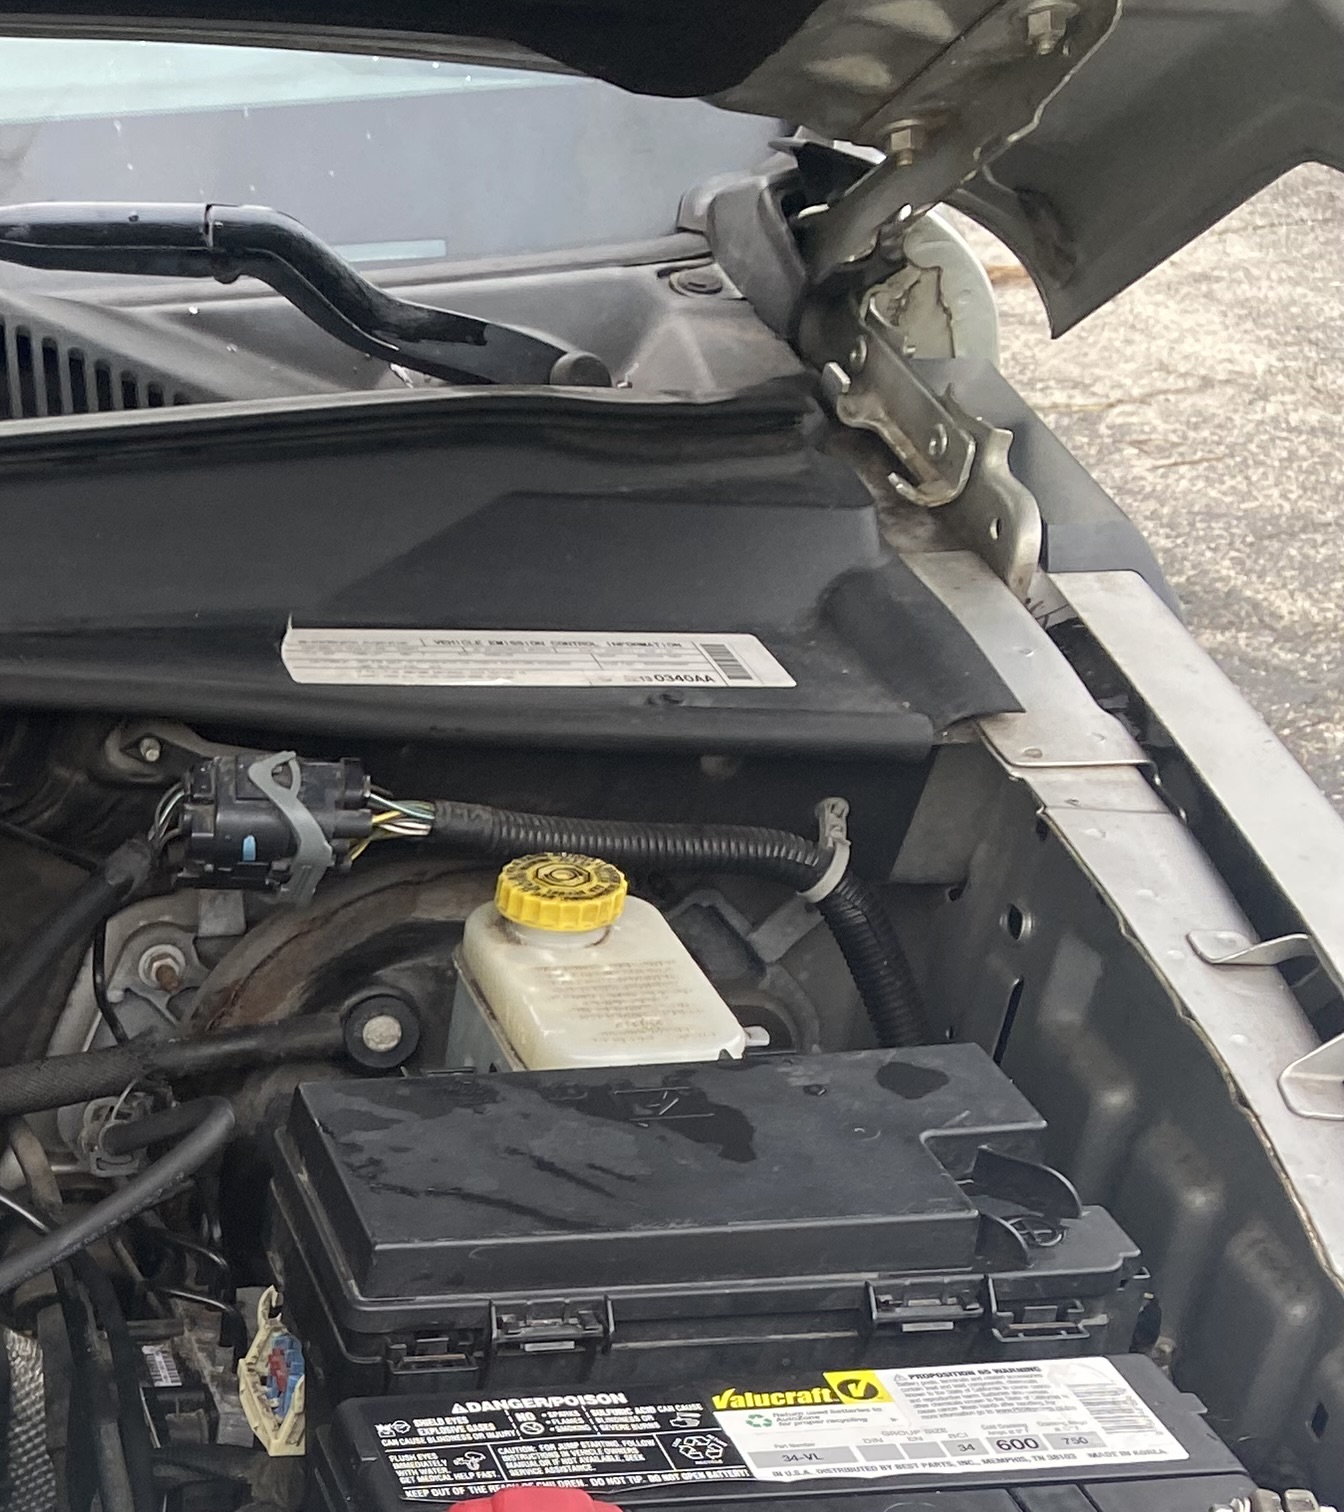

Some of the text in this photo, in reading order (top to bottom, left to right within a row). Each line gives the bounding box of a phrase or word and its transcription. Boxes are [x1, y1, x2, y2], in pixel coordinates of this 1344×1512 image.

[466, 1393, 628, 1413] DANGER/POISON
[712, 1388, 832, 1410] Valucraft
[782, 1437, 1088, 1462] 34-VL 34 600 750
